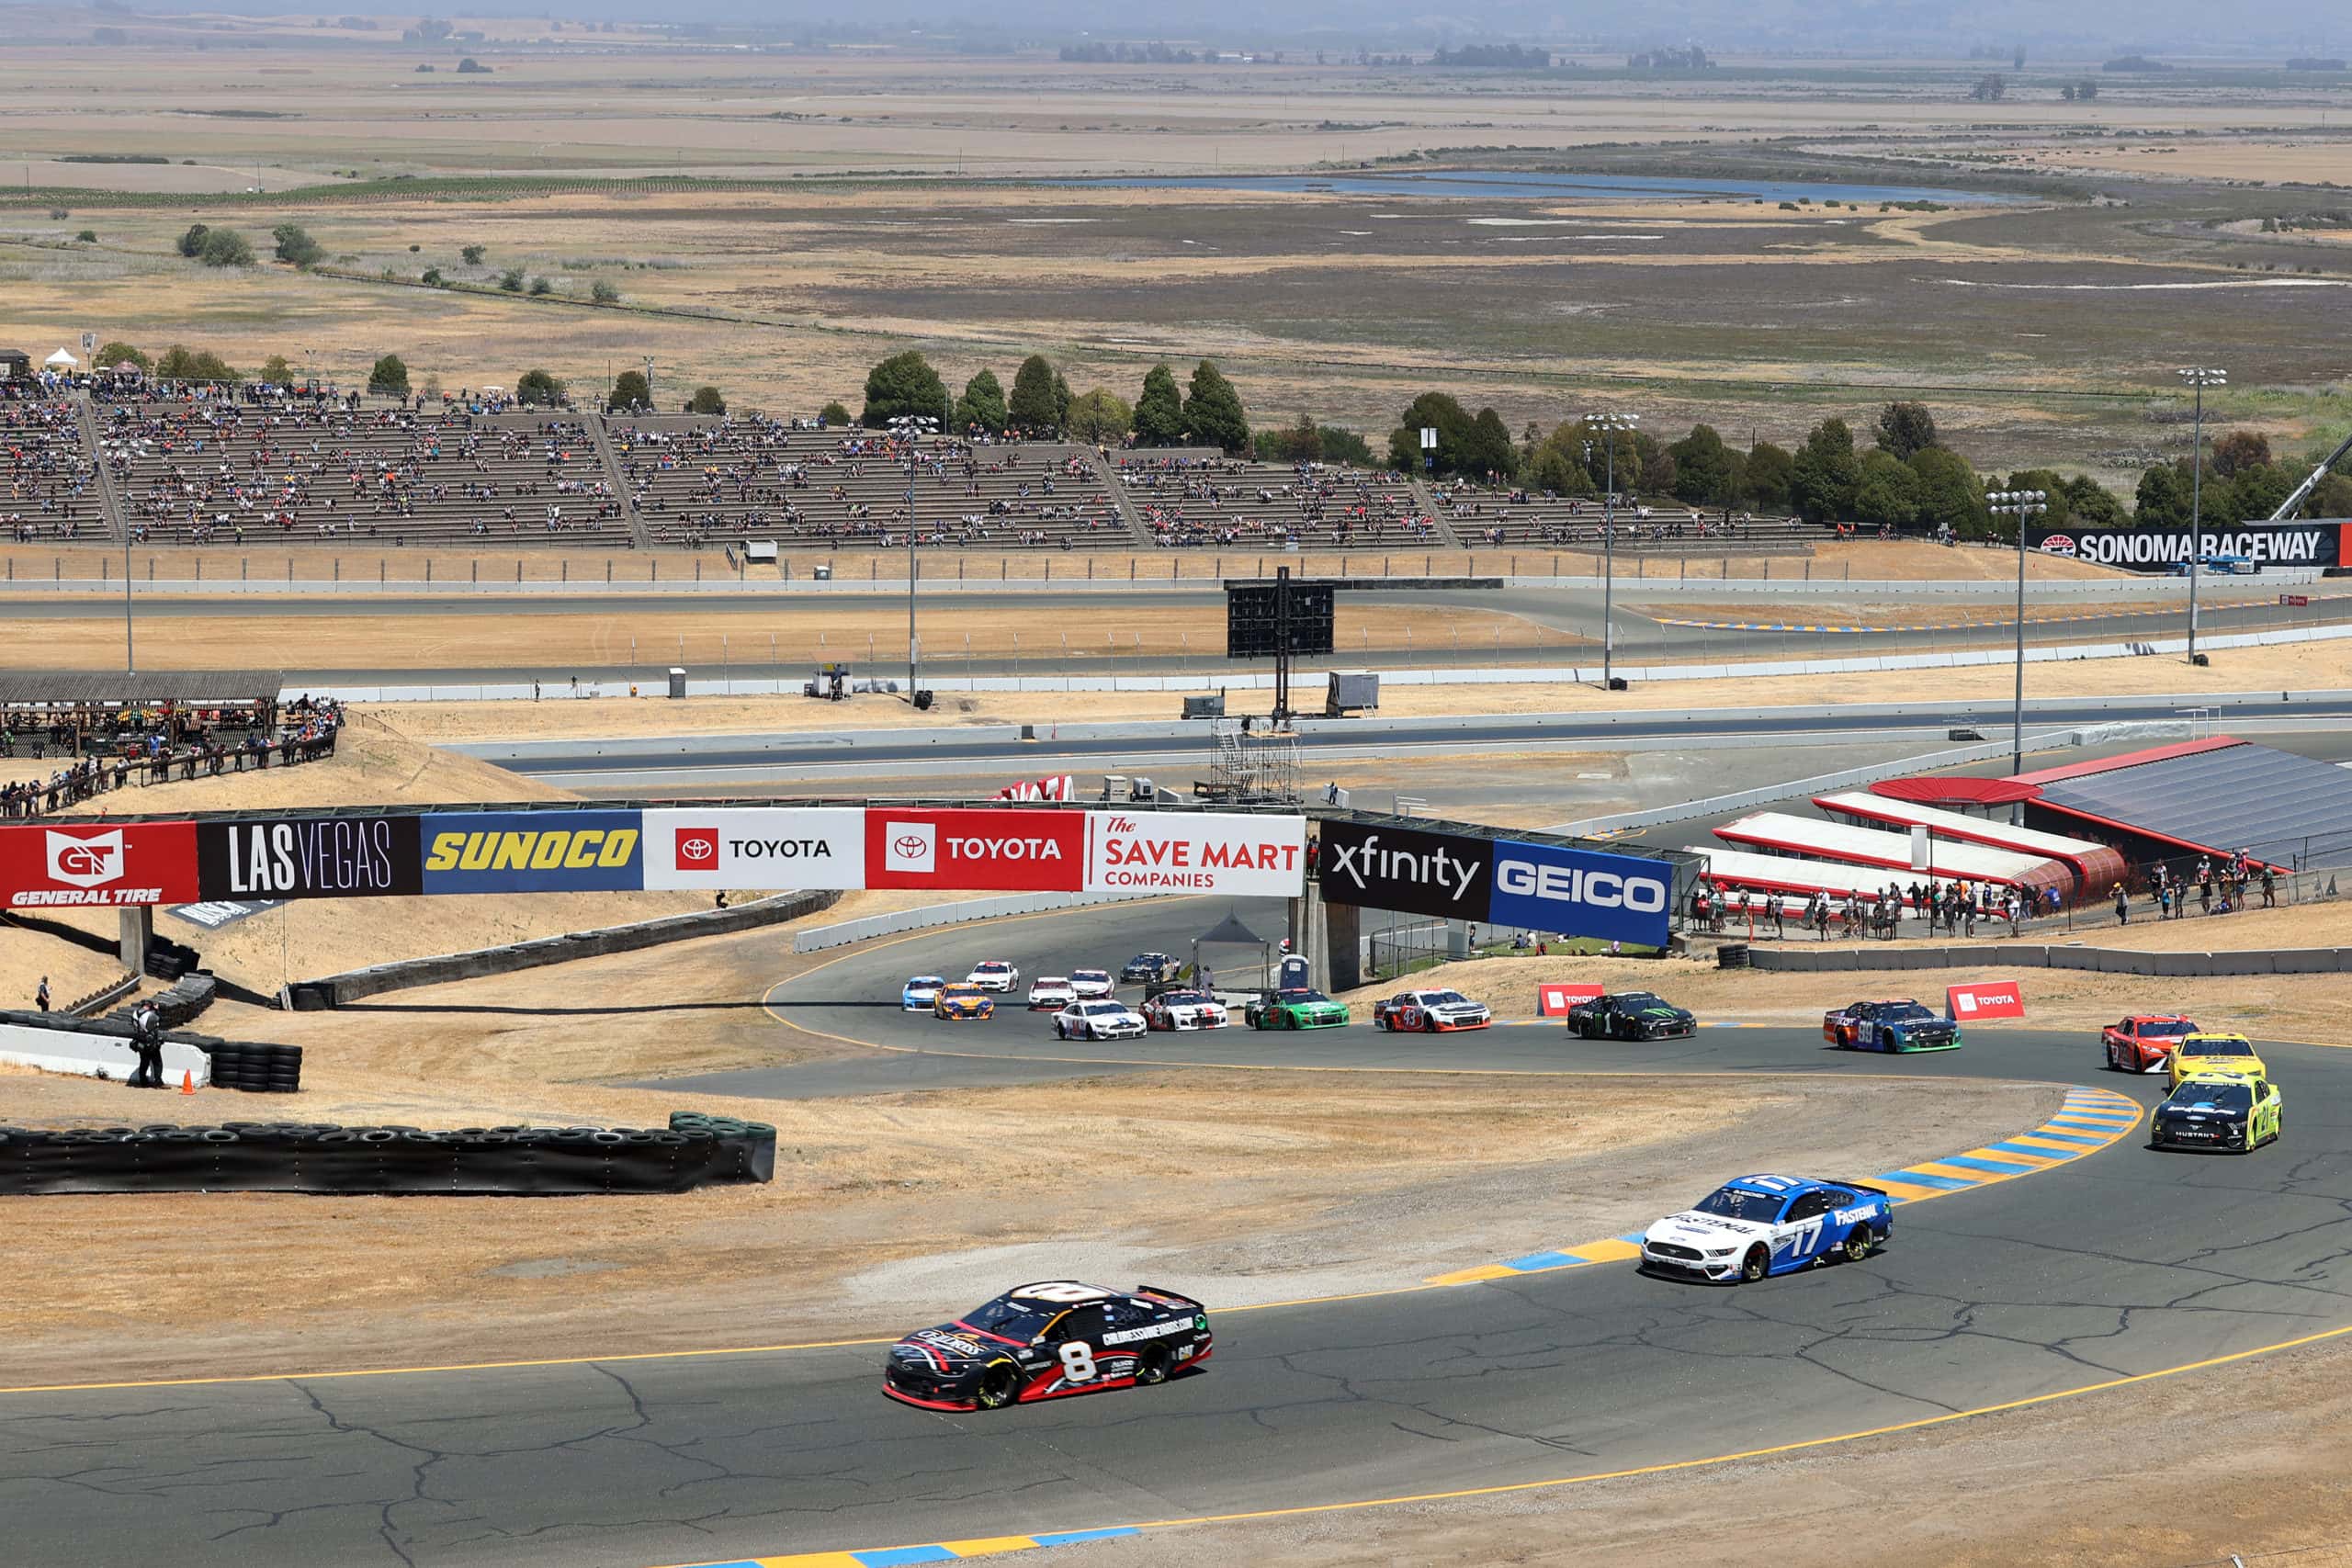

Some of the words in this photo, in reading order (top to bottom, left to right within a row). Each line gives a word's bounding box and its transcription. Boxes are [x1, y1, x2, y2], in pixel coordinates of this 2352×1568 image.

[2079, 534, 2194, 563] SONOMA
[2200, 531, 2321, 561] RACEWAY
[1105, 816, 1136, 833] The
[229, 823, 296, 893] LAS
[297, 819, 390, 890] VEGAS
[425, 829, 639, 871] SUNOCO
[729, 840, 831, 859] TOYOTA
[946, 837, 1062, 861] TOYOTA
[1105, 839, 1190, 868] SAVE
[1200, 842, 1299, 871] MART
[1104, 871, 1215, 888] COMPANIES
[1330, 836, 1481, 901] xfinity
[11, 889, 110, 906] GENERAL
[114, 887, 163, 904] TIRE
[1496, 859, 1666, 914] GEICO
[1976, 994, 2015, 1006] TOYOTA
[1403, 1010, 1415, 1026] 43
[1604, 1012, 1612, 1034] 1
[1858, 1020, 1874, 1043] 99
[1833, 1203, 1879, 1226] FASTENAL
[1792, 1220, 1824, 1258] 17
[1057, 1340, 1098, 1383] 8
[1178, 1344, 1194, 1361] CAT
